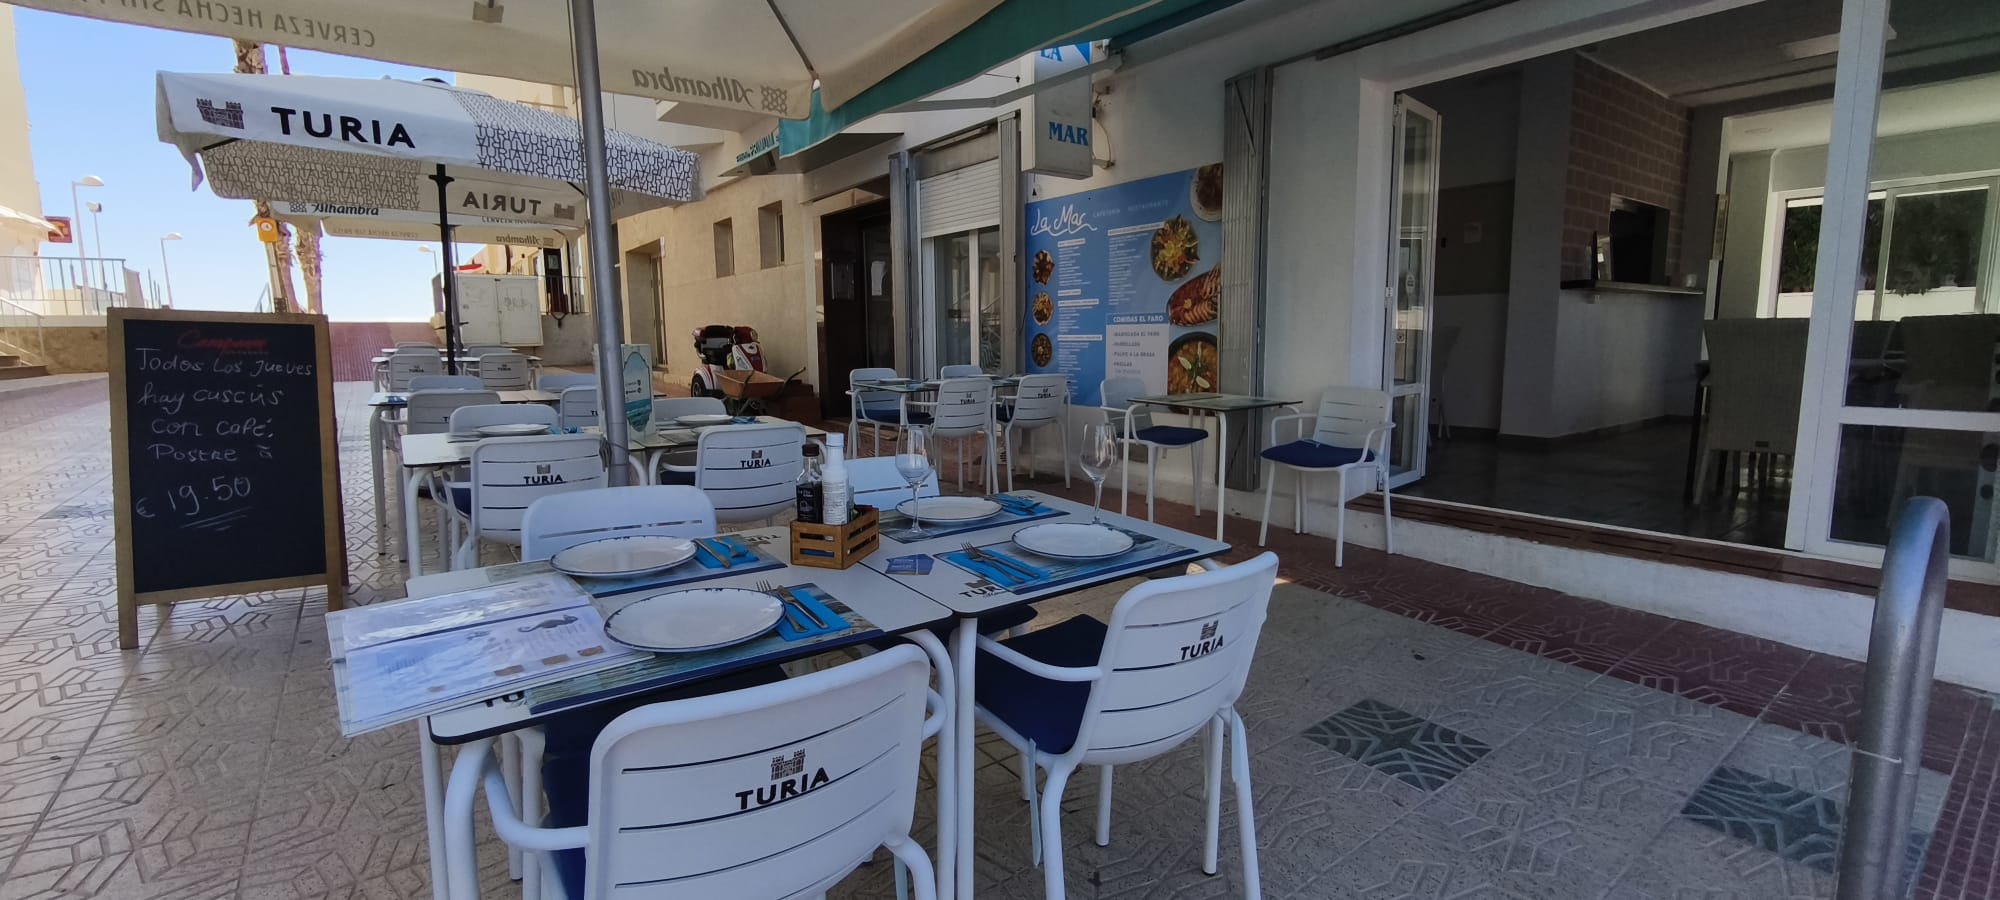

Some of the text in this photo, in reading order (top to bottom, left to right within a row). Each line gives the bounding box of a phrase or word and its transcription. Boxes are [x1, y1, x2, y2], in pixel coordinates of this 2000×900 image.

[270, 106, 416, 149] TURIA
[1048, 121, 1090, 147] MAR
[311, 202, 379, 216] Alhambra
[1031, 208, 1051, 235] La
[1052, 204, 1097, 236] Mar
[136, 347, 204, 372] Todos
[740, 458, 772, 468] TURIA
[523, 474, 564, 484] TURIA
[167, 476, 251, 516] 19.50
[959, 585, 1003, 598] TUR
[1180, 635, 1224, 661] TURIA
[735, 767, 830, 810] TURIA
